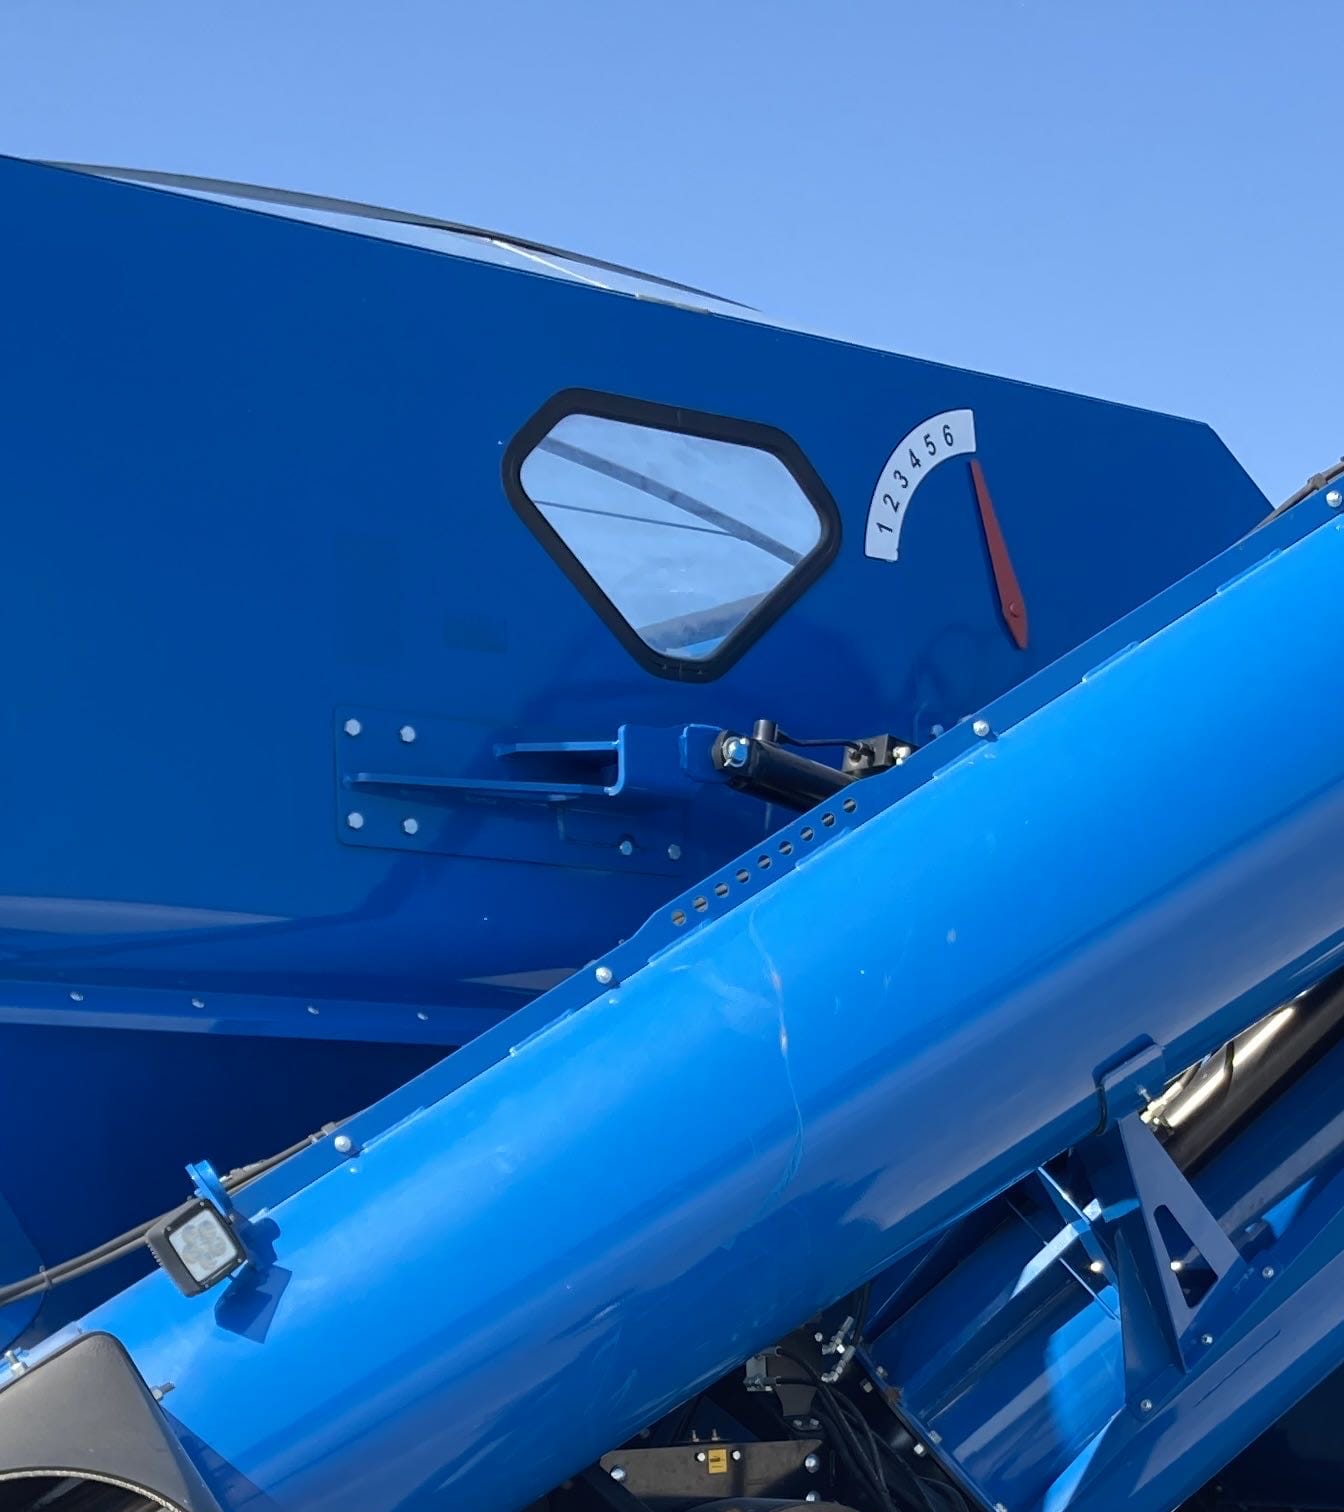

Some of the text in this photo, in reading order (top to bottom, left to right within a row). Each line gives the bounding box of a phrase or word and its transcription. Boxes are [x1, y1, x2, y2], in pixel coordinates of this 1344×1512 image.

[876, 424, 954, 533] 1 2 3 4 5 6
